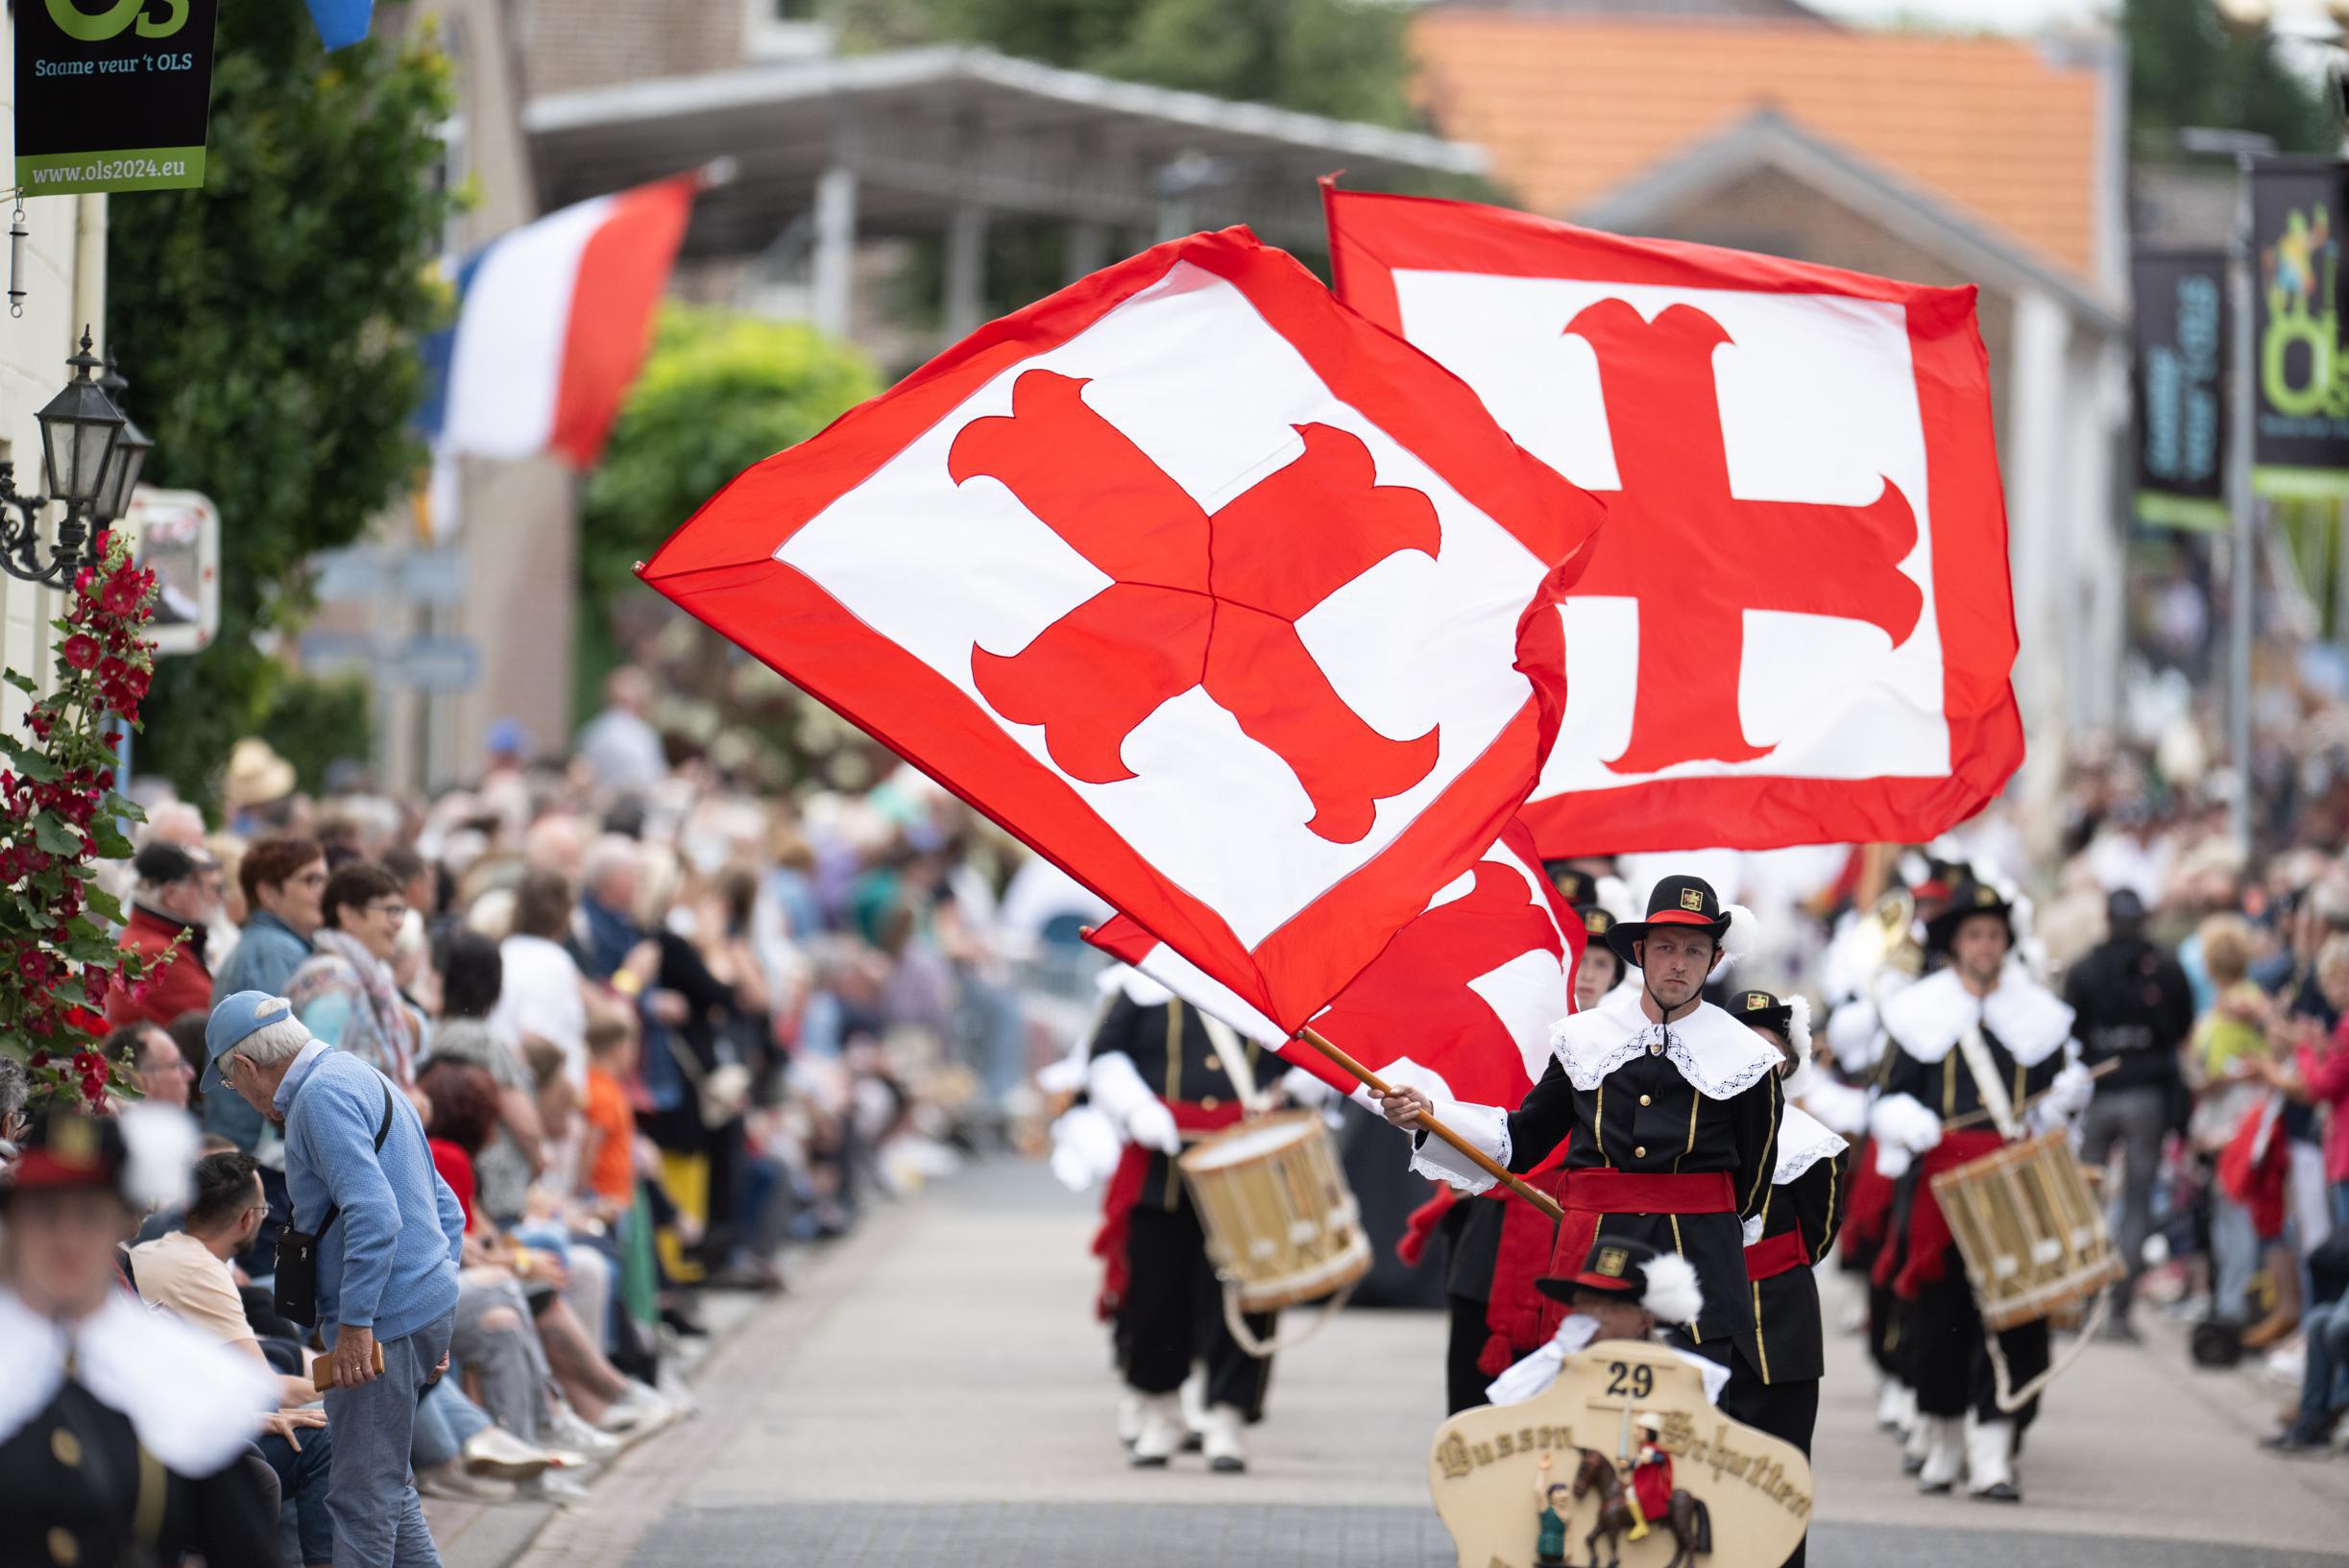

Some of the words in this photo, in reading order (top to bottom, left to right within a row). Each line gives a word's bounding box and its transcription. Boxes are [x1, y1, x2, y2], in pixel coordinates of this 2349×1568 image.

[36, 60, 94, 77] Saame
[98, 58, 138, 74] veur
[157, 53, 192, 70] OLS
[33, 159, 185, 183] www.ols2024.eu
[1607, 1361, 1653, 1399] 29
